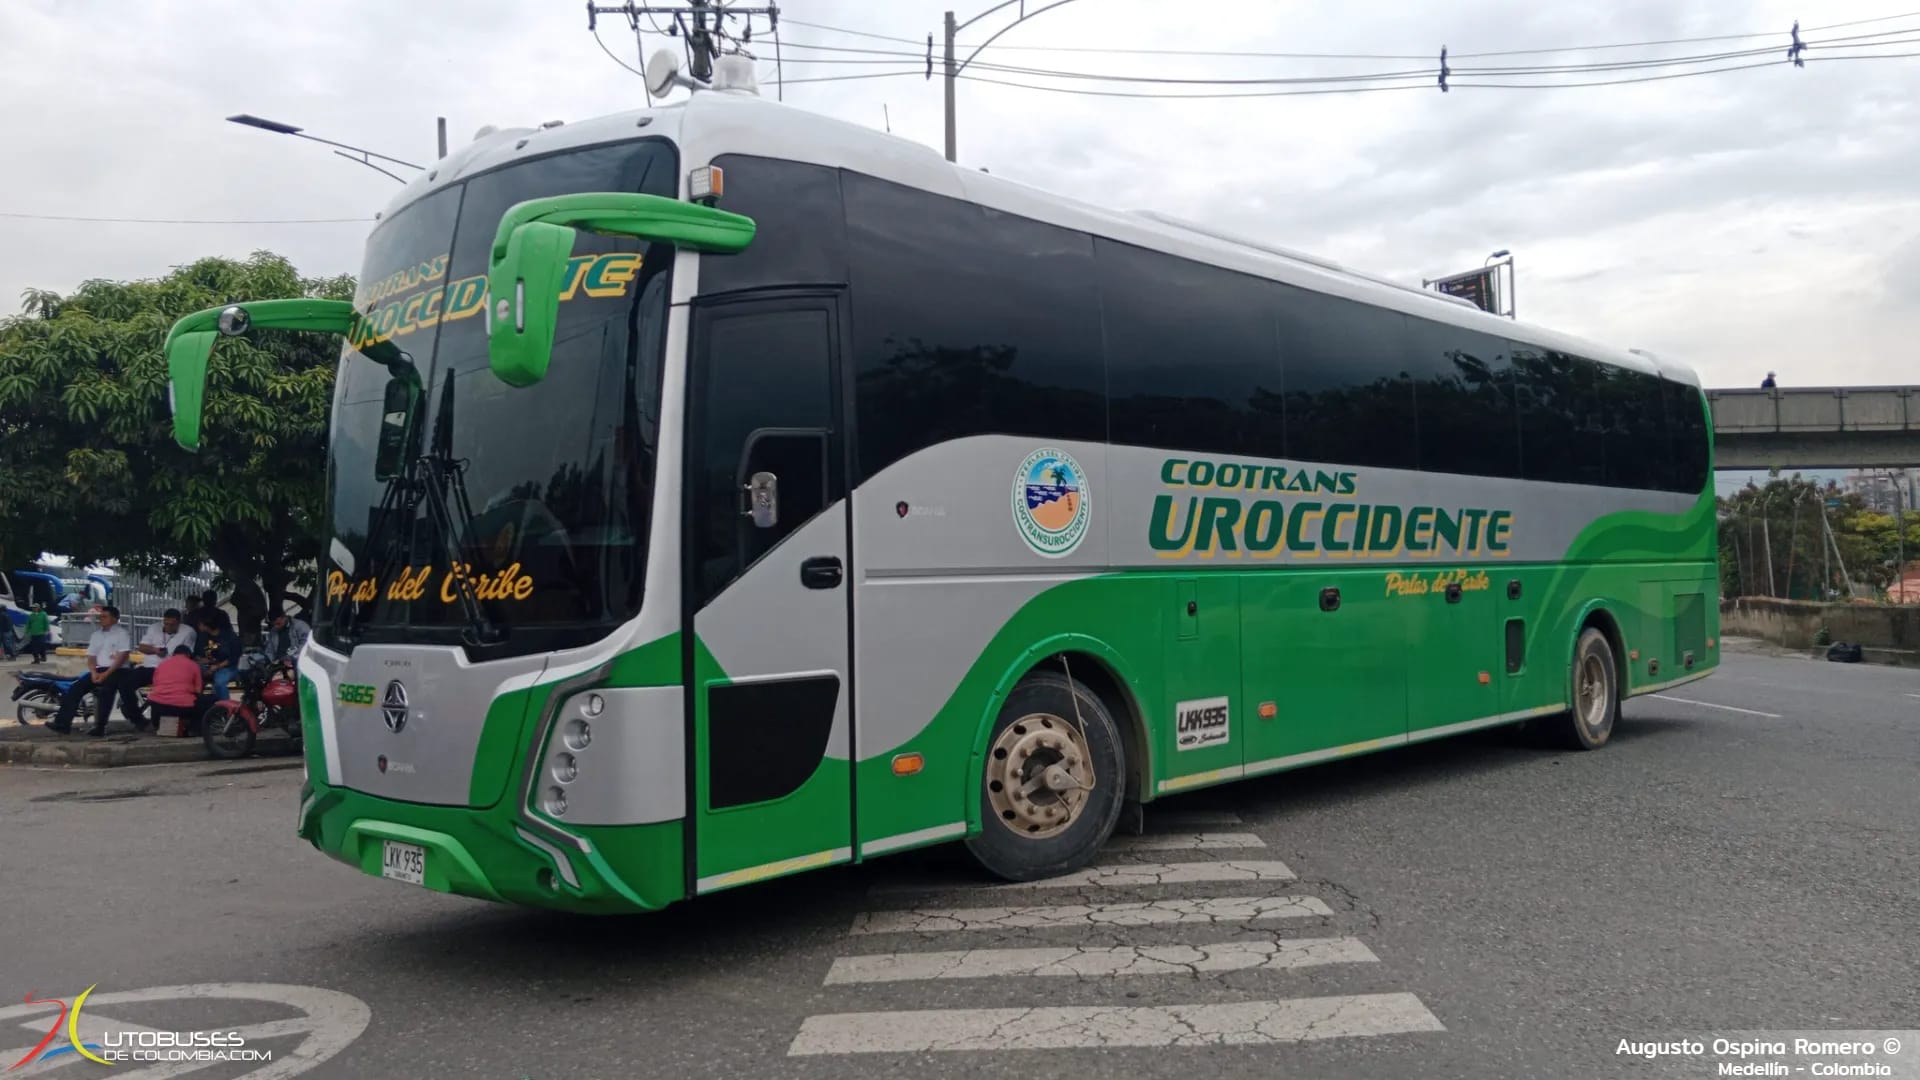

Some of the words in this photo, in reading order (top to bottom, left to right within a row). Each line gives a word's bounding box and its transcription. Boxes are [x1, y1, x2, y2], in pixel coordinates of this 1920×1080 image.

[1161, 458, 1357, 495] COOTRANS
[1149, 494, 1513, 559] UROCCIDENTE
[387, 565, 432, 601] del
[384, 846, 401, 870] LKK
[403, 849, 423, 874] 935
